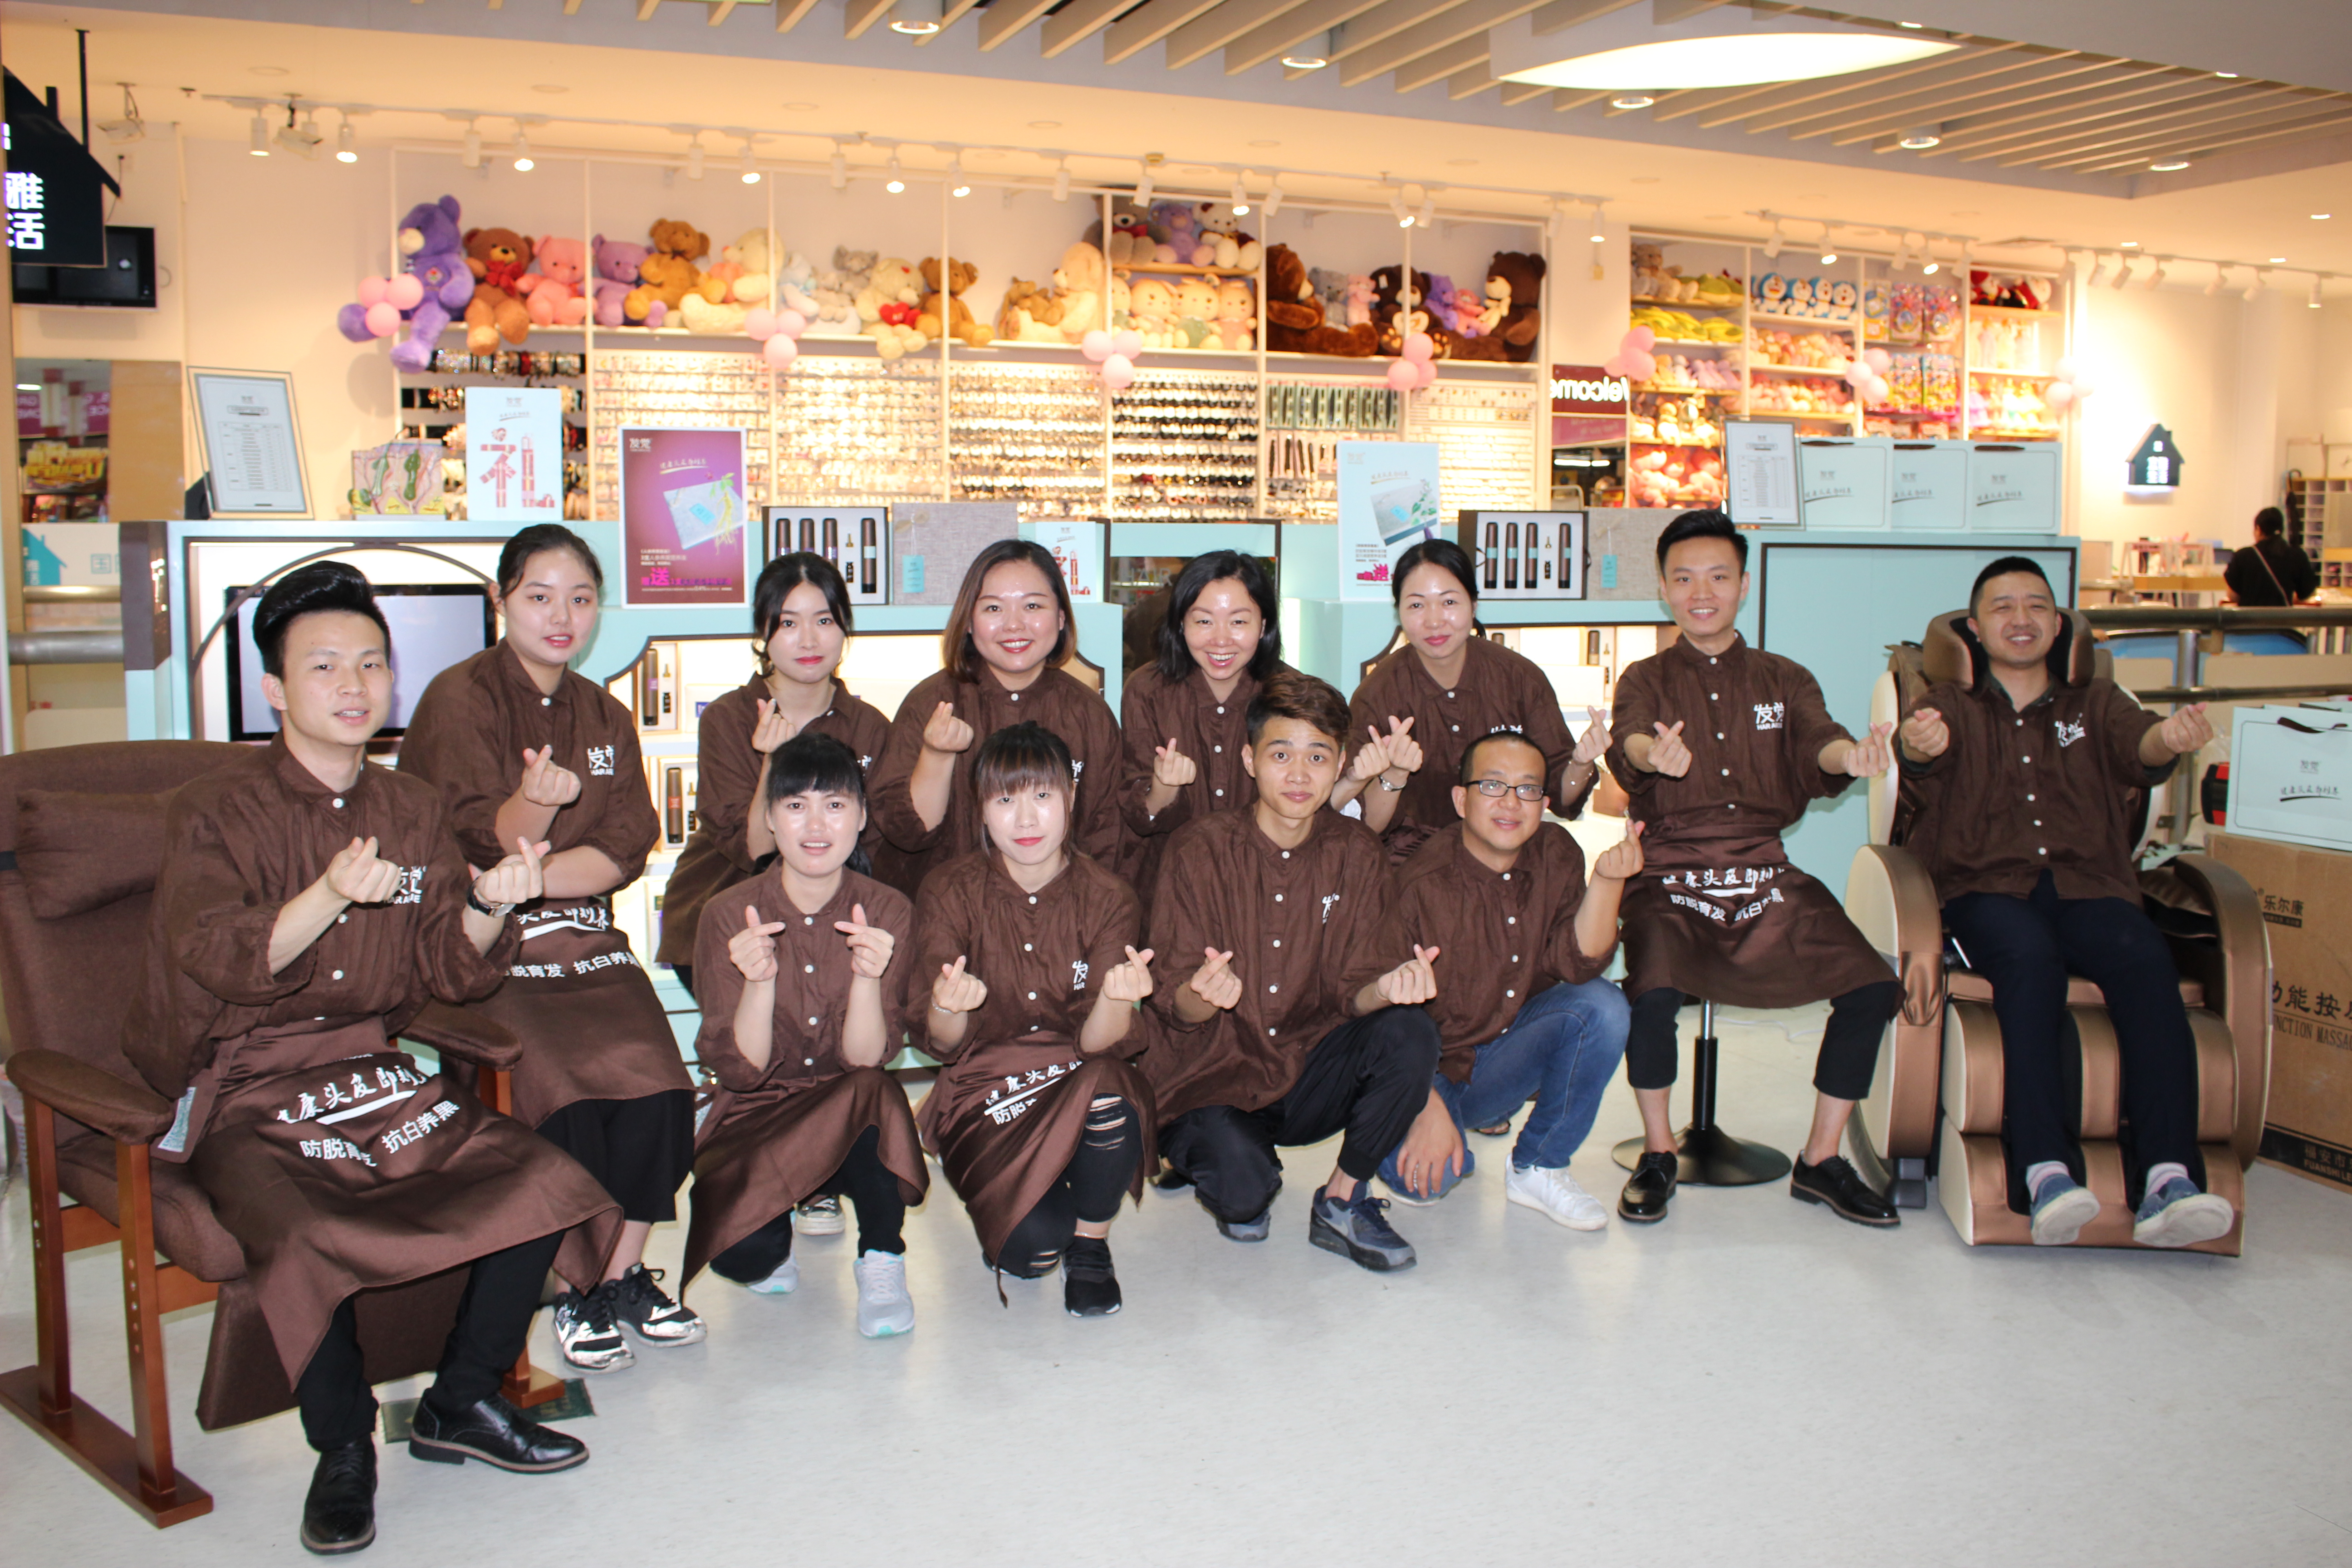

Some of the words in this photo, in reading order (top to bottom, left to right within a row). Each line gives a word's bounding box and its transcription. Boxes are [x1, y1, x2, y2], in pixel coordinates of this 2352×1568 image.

[2264, 896, 2304, 916] 乐尔康
[505, 963, 566, 978] 脱育发
[382, 1100, 460, 1154] 抗白养黑
[2305, 1144, 2352, 1170] 福安市
